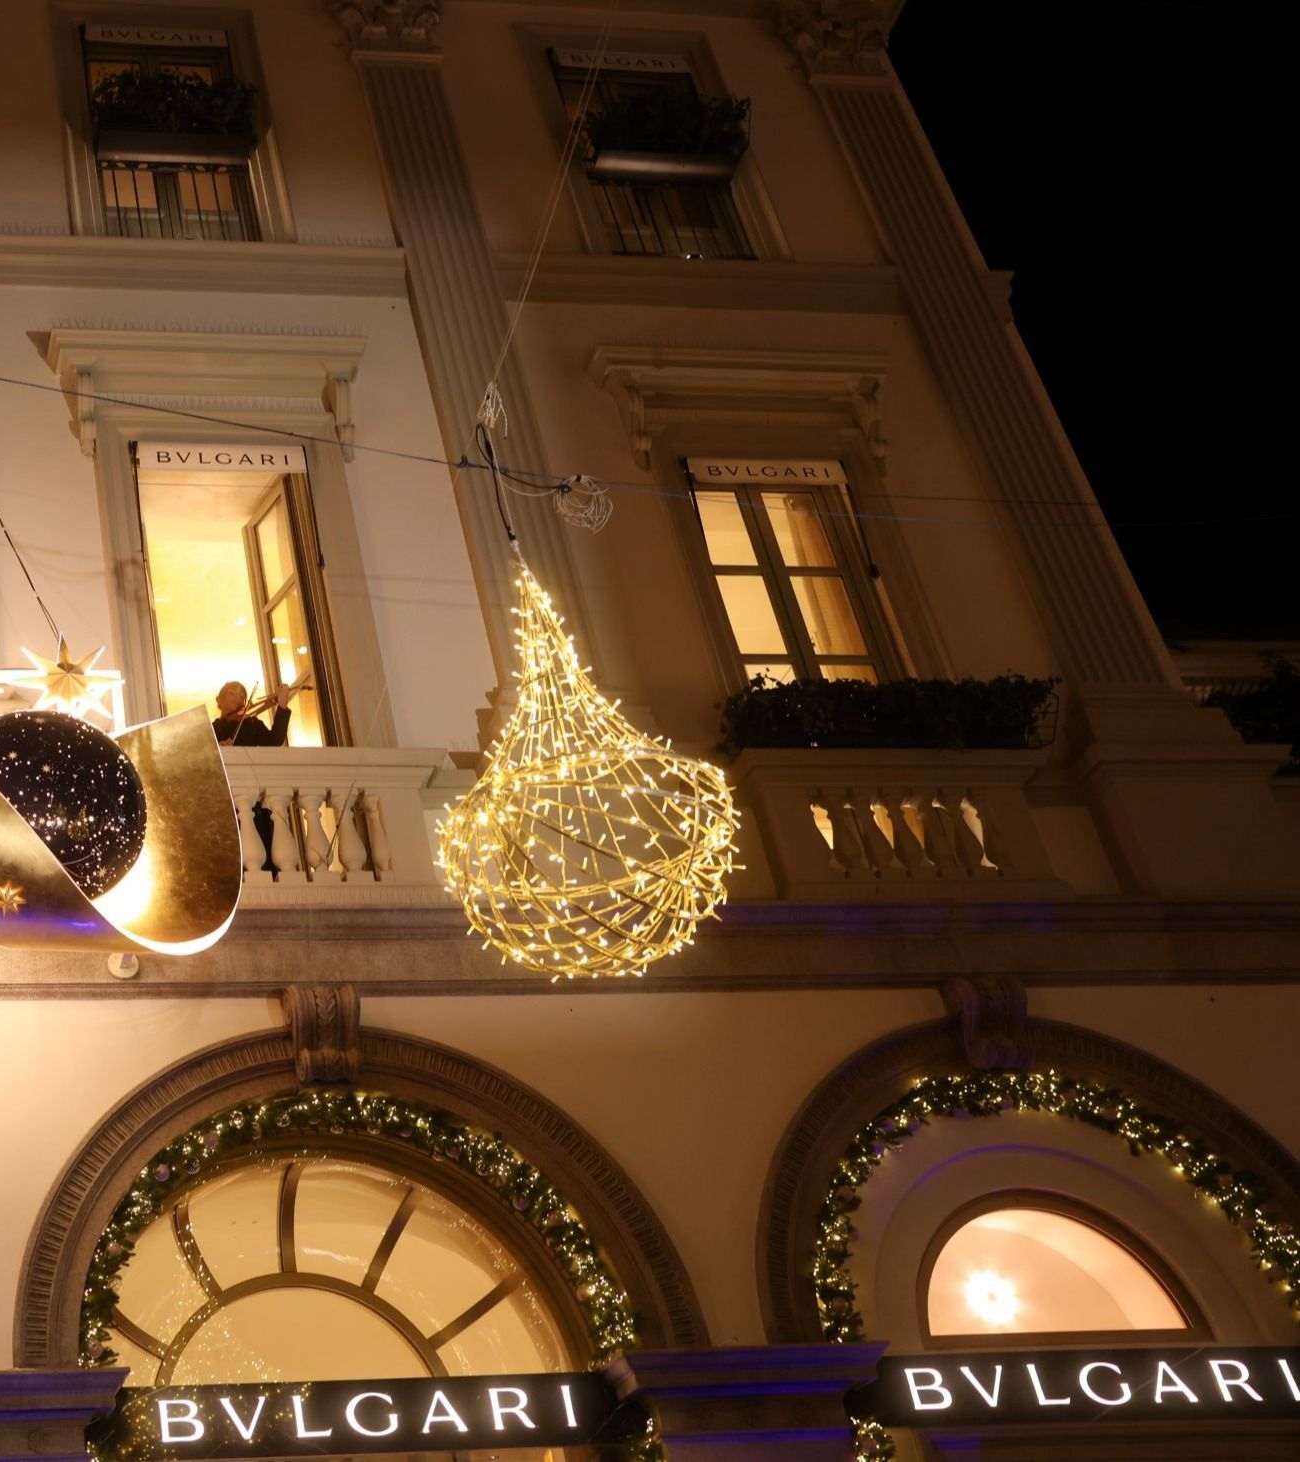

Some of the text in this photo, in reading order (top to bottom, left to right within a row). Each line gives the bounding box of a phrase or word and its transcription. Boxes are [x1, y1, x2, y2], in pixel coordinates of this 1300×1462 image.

[157, 451, 289, 466] BVLGARI
[707, 465, 830, 478] BVLGARI
[903, 1358, 1300, 1411] BVLGARI
[157, 1384, 578, 1443] BVLGARI
